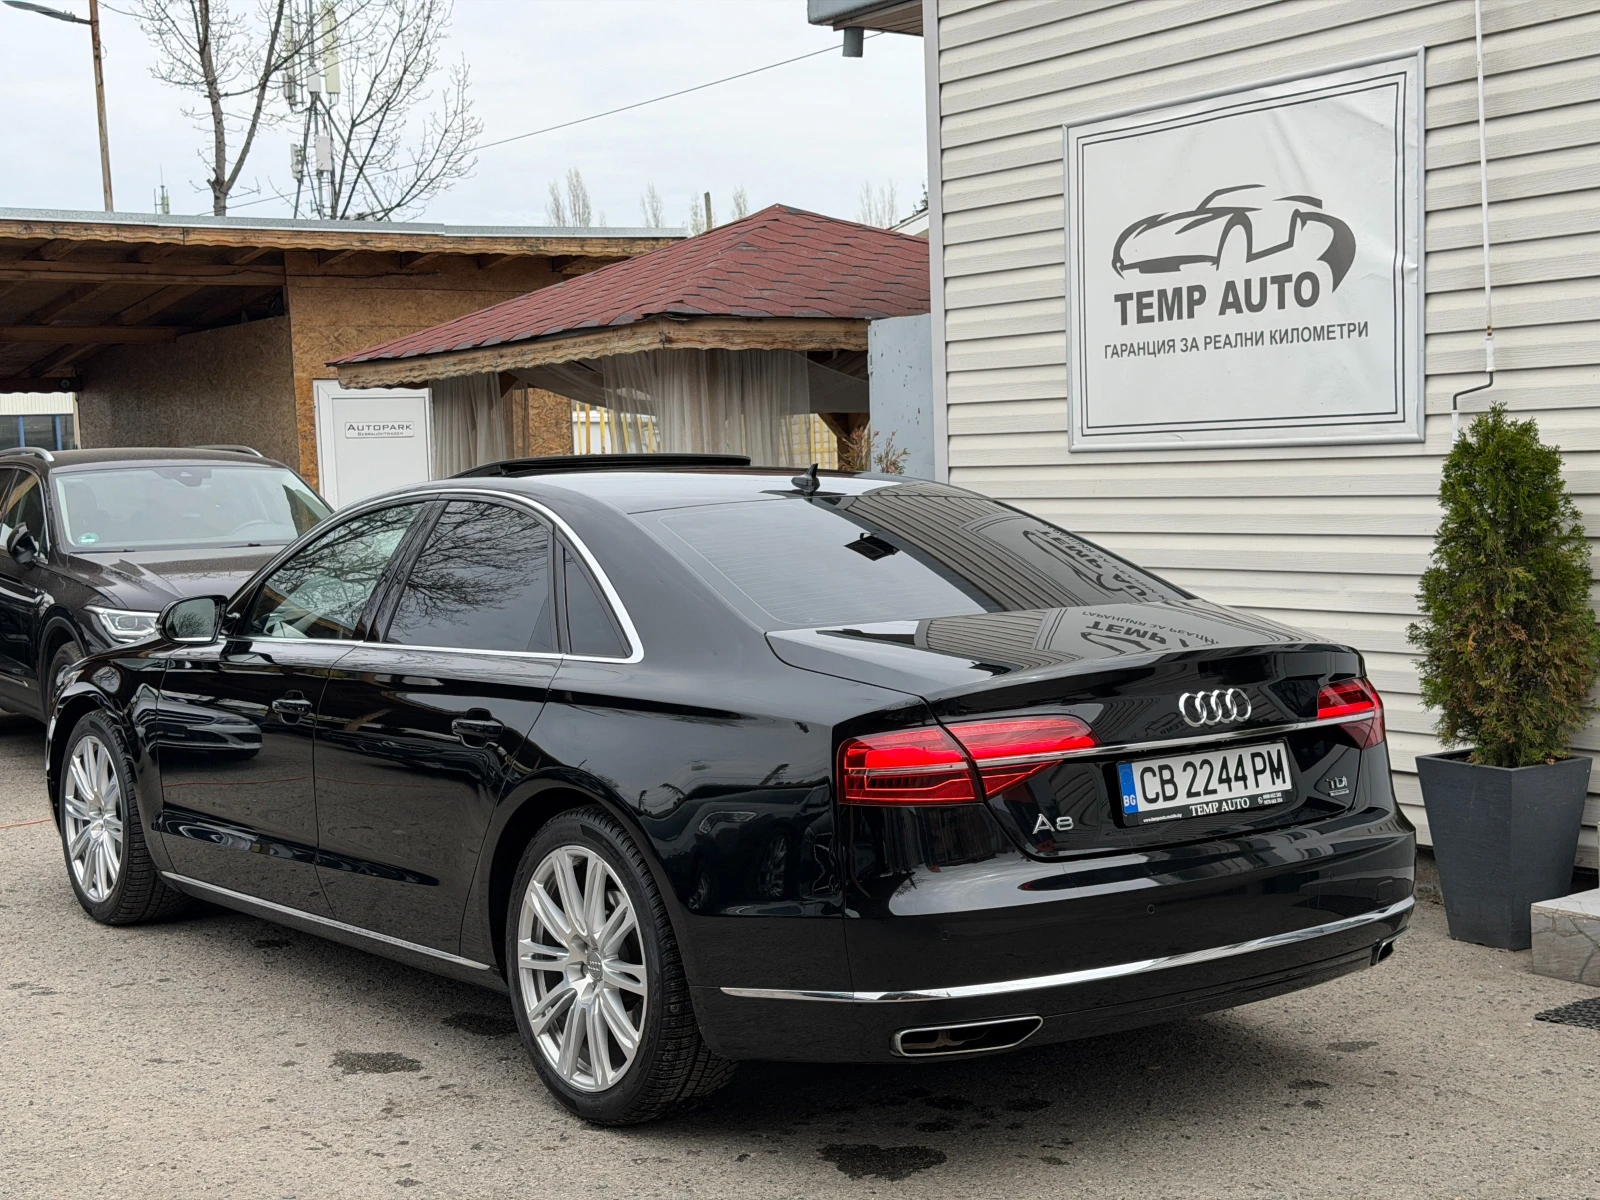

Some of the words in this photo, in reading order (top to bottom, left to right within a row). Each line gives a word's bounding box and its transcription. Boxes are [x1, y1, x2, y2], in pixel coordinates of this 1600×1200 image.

[1114, 284, 1207, 326] TEMP
[1218, 271, 1320, 316] AUTO
[1104, 338, 1176, 359] ГАРАНЦИЯ
[1180, 336, 1200, 352] ЗА
[1204, 330, 1265, 351] РЕАЛНИ
[1270, 321, 1369, 344] КИЛОМЕТРИ
[1139, 764, 1179, 804] CB
[1182, 753, 1248, 798] 2244
[1250, 749, 1287, 789] PM
[1122, 794, 1137, 807] BG
[1189, 803, 1219, 817] TEMP
[1221, 798, 1250, 812] AUTO
[1032, 812, 1074, 835] A8
